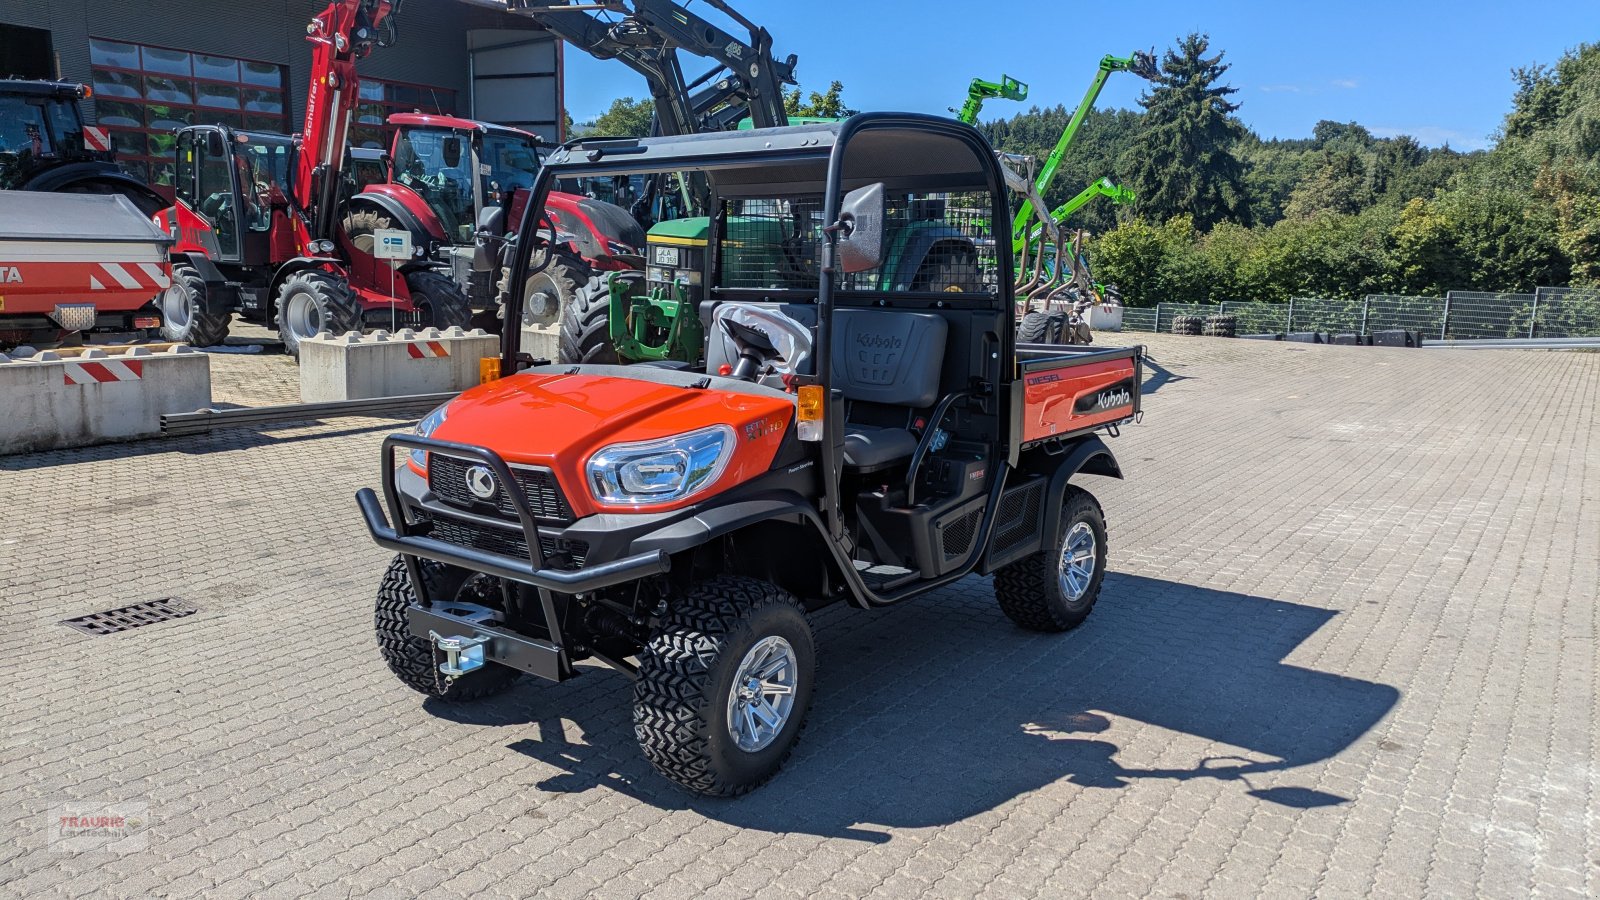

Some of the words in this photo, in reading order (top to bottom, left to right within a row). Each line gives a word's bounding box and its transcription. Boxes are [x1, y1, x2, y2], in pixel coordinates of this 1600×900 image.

[305, 78, 318, 141] Schäffer
[856, 332, 903, 349] Kubota
[1027, 374, 1060, 386] DIESEL
[1097, 388, 1131, 410] Kubota
